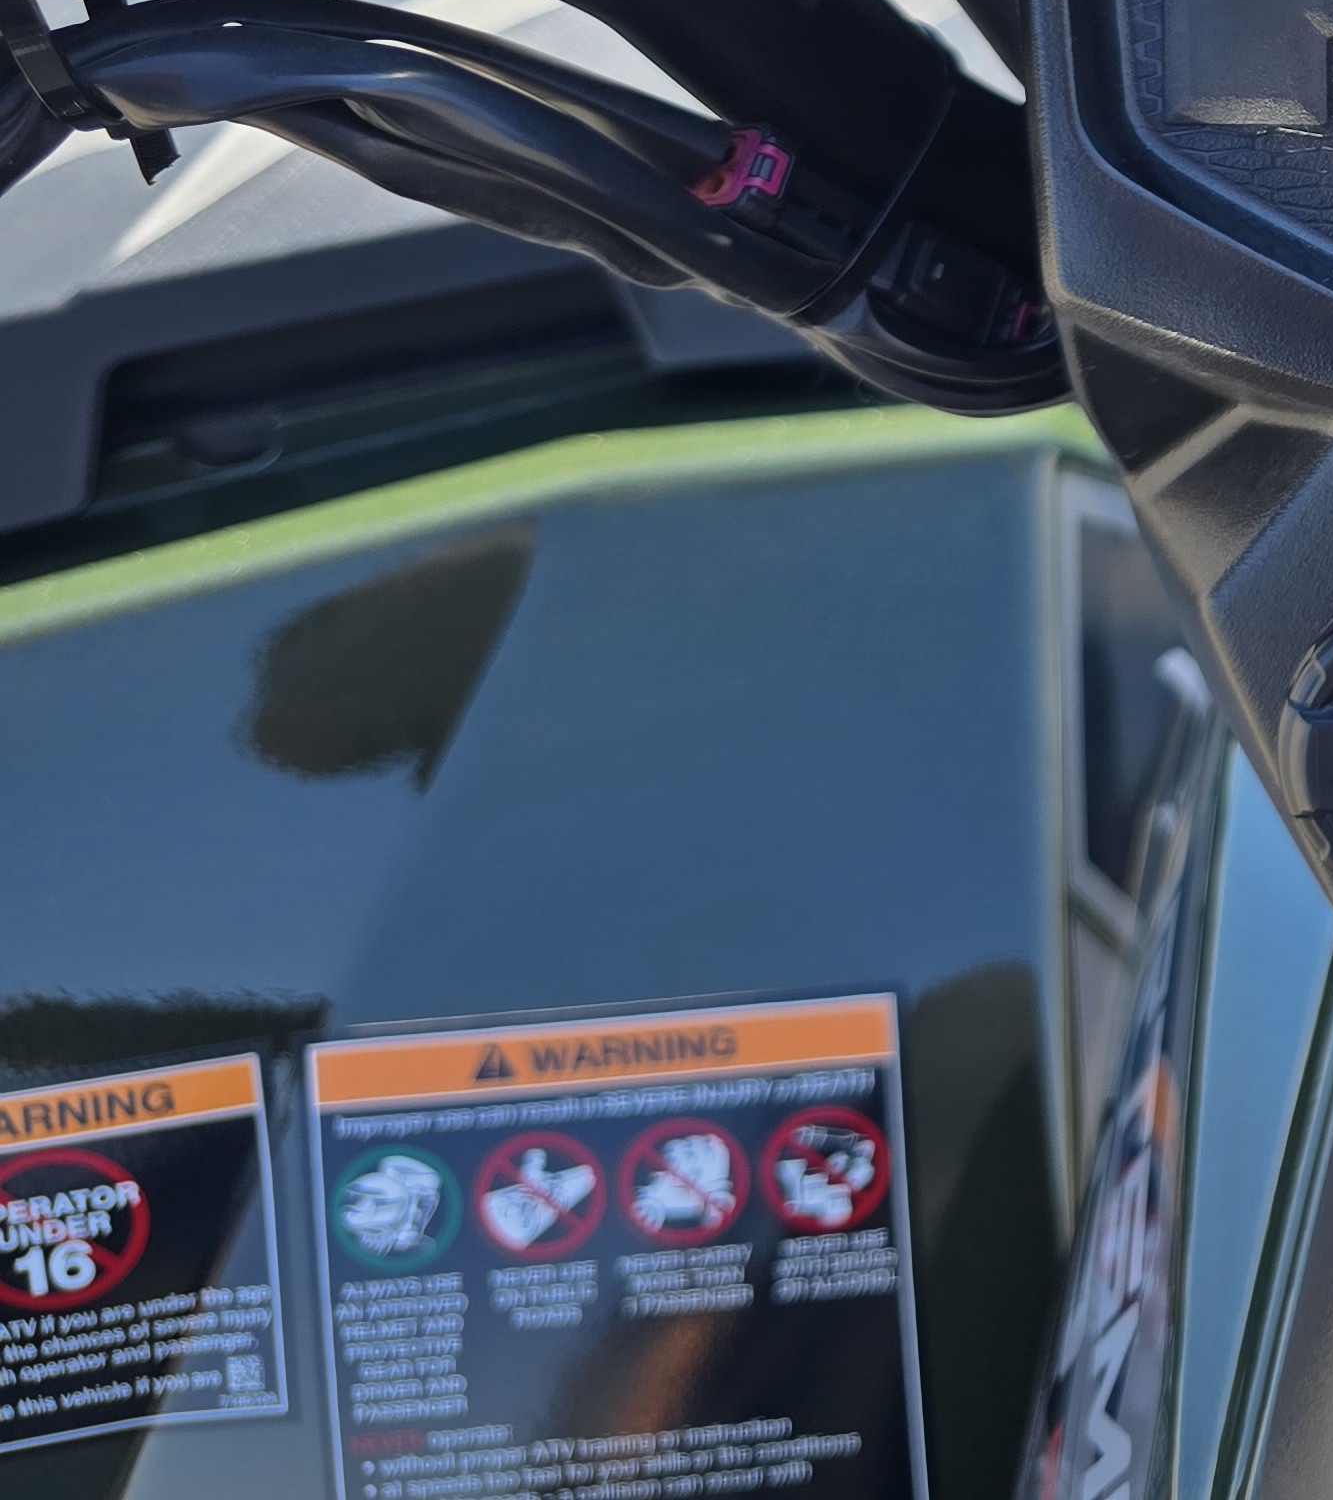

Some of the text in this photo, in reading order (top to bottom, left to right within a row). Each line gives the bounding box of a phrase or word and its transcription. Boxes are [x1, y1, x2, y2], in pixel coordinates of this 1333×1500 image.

[531, 1025, 740, 1073] WARNING
[0, 1082, 175, 1138] ARNING
[0, 1181, 141, 1226] ERATOR
[14, 1238, 97, 1298] 16
